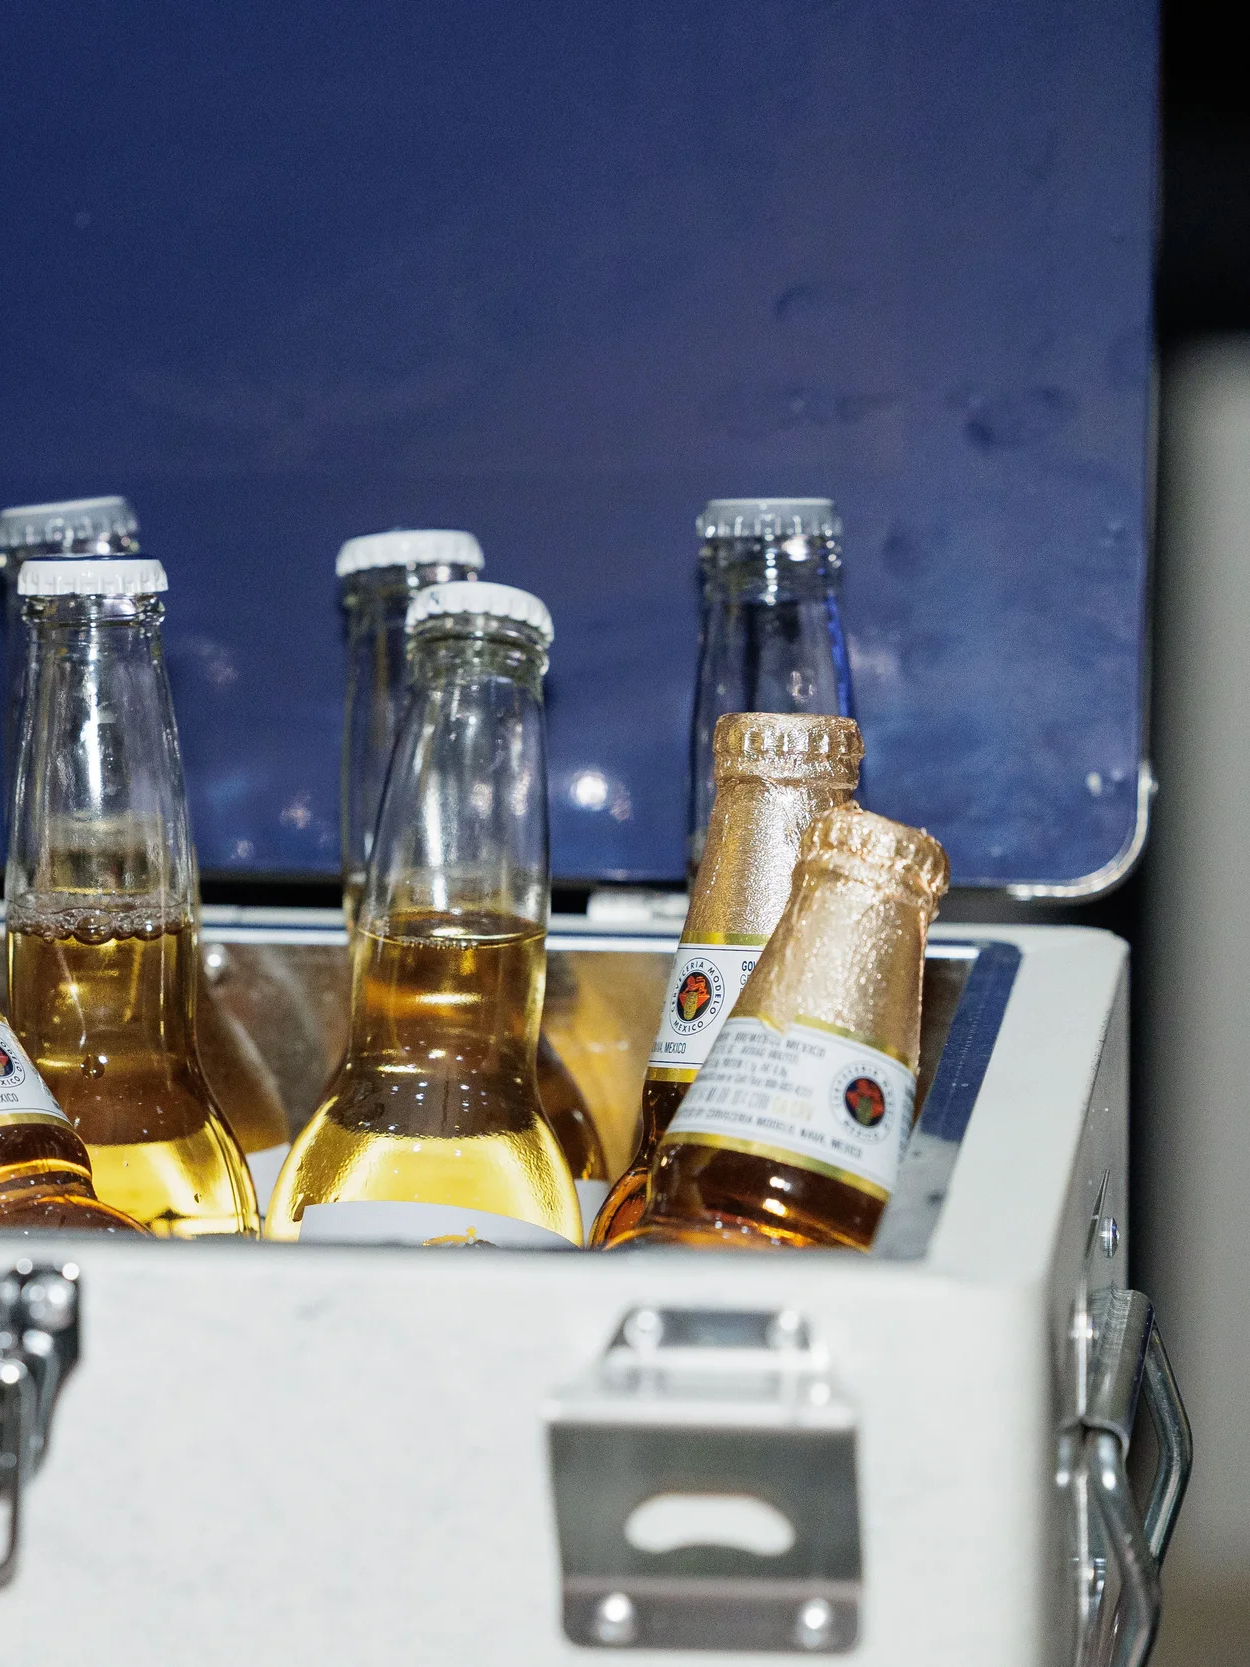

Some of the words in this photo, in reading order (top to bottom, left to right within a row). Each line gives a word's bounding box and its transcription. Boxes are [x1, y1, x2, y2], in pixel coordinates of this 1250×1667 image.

[707, 966, 723, 1015] MODELO
[673, 1019, 704, 1033] MEXICO
[664, 1042, 687, 1054] MEXICO
